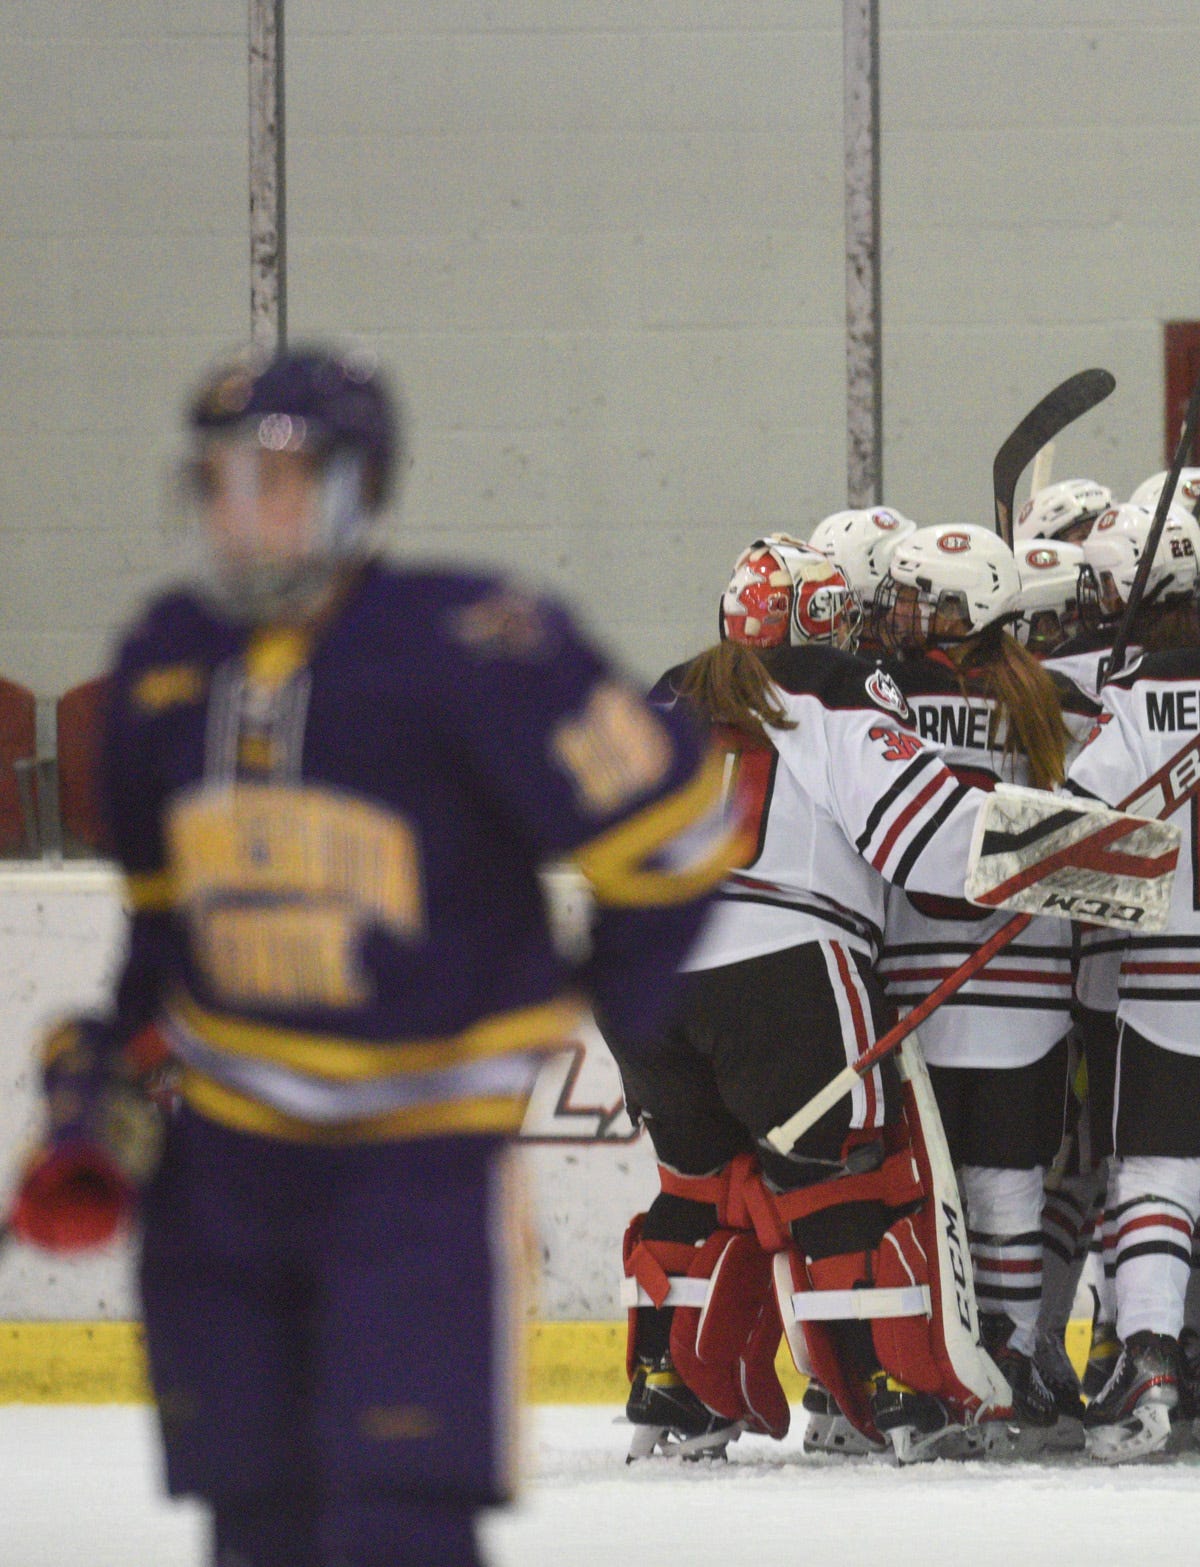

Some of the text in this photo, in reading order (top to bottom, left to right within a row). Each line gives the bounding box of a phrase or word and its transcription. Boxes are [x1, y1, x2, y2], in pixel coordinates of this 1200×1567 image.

[1169, 537, 1195, 559] 22
[1041, 892, 1146, 923] CCM
[941, 1200, 972, 1333] CCM
